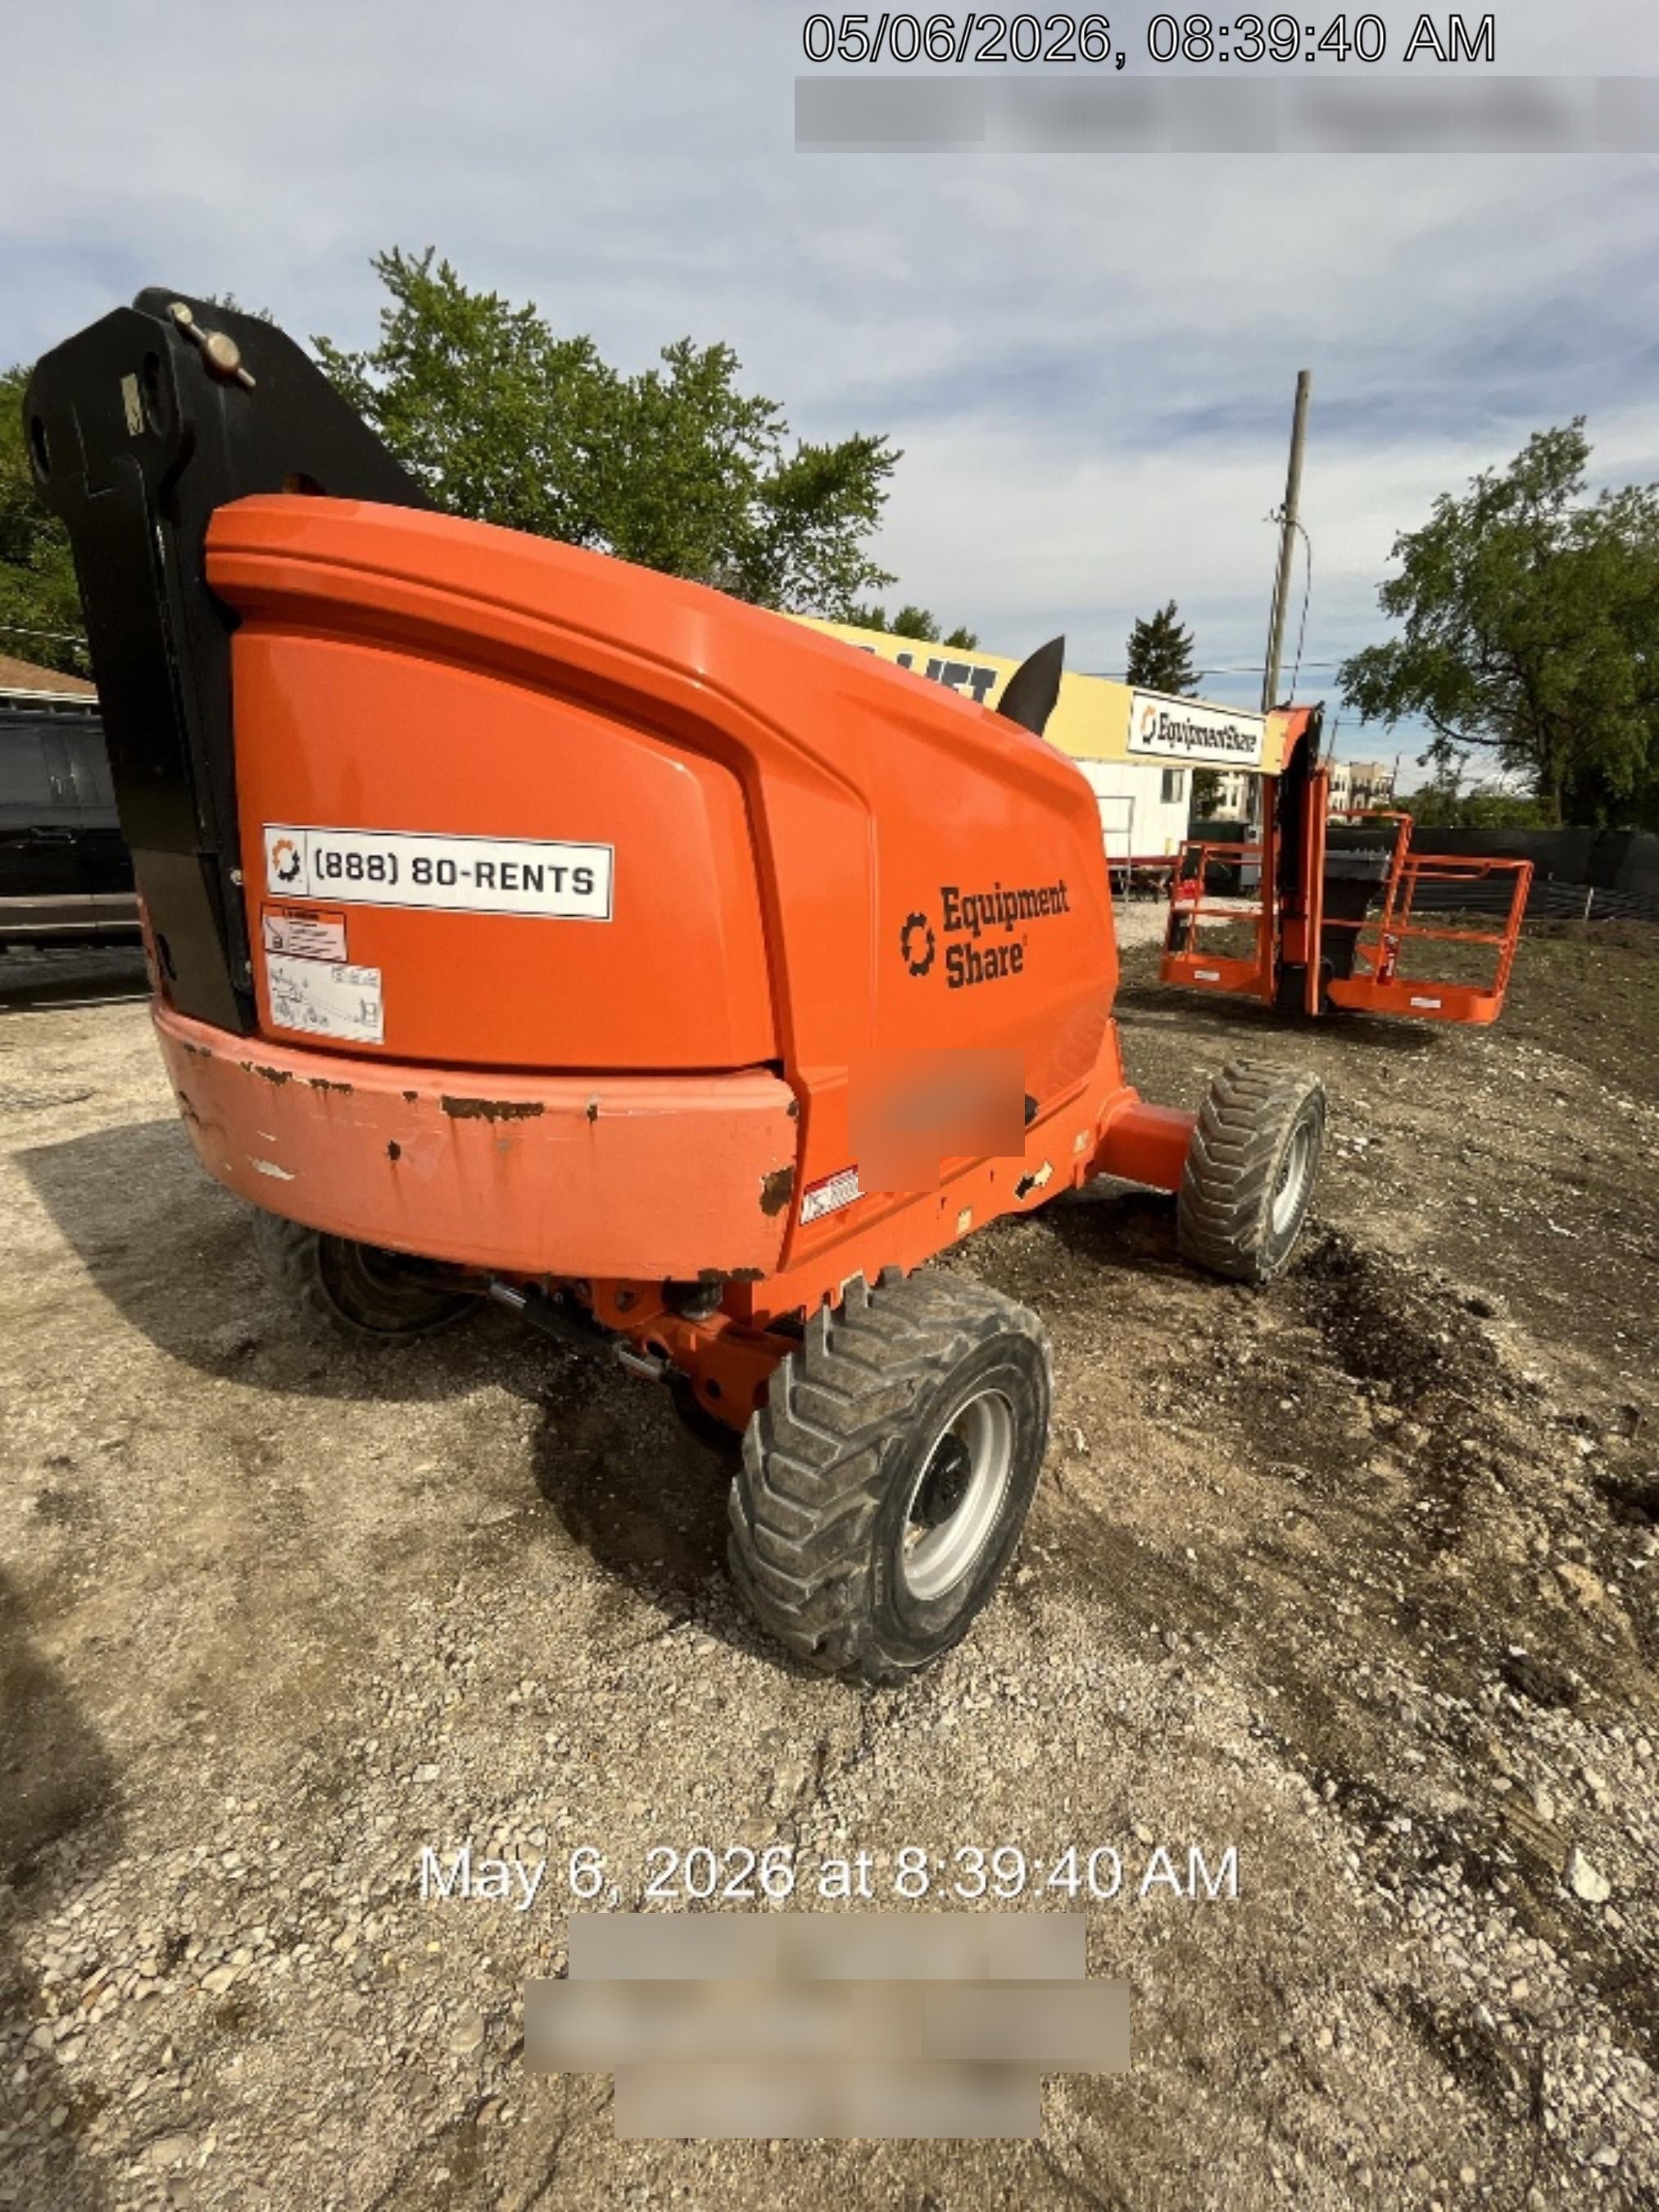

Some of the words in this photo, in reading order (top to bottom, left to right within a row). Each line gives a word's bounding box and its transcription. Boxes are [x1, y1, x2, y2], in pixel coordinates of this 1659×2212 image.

[315, 848, 398, 885] (888)
[412, 858, 594, 895] 80-RENTS
[941, 880, 1070, 938] Equipment
[945, 942, 1023, 989] Share
